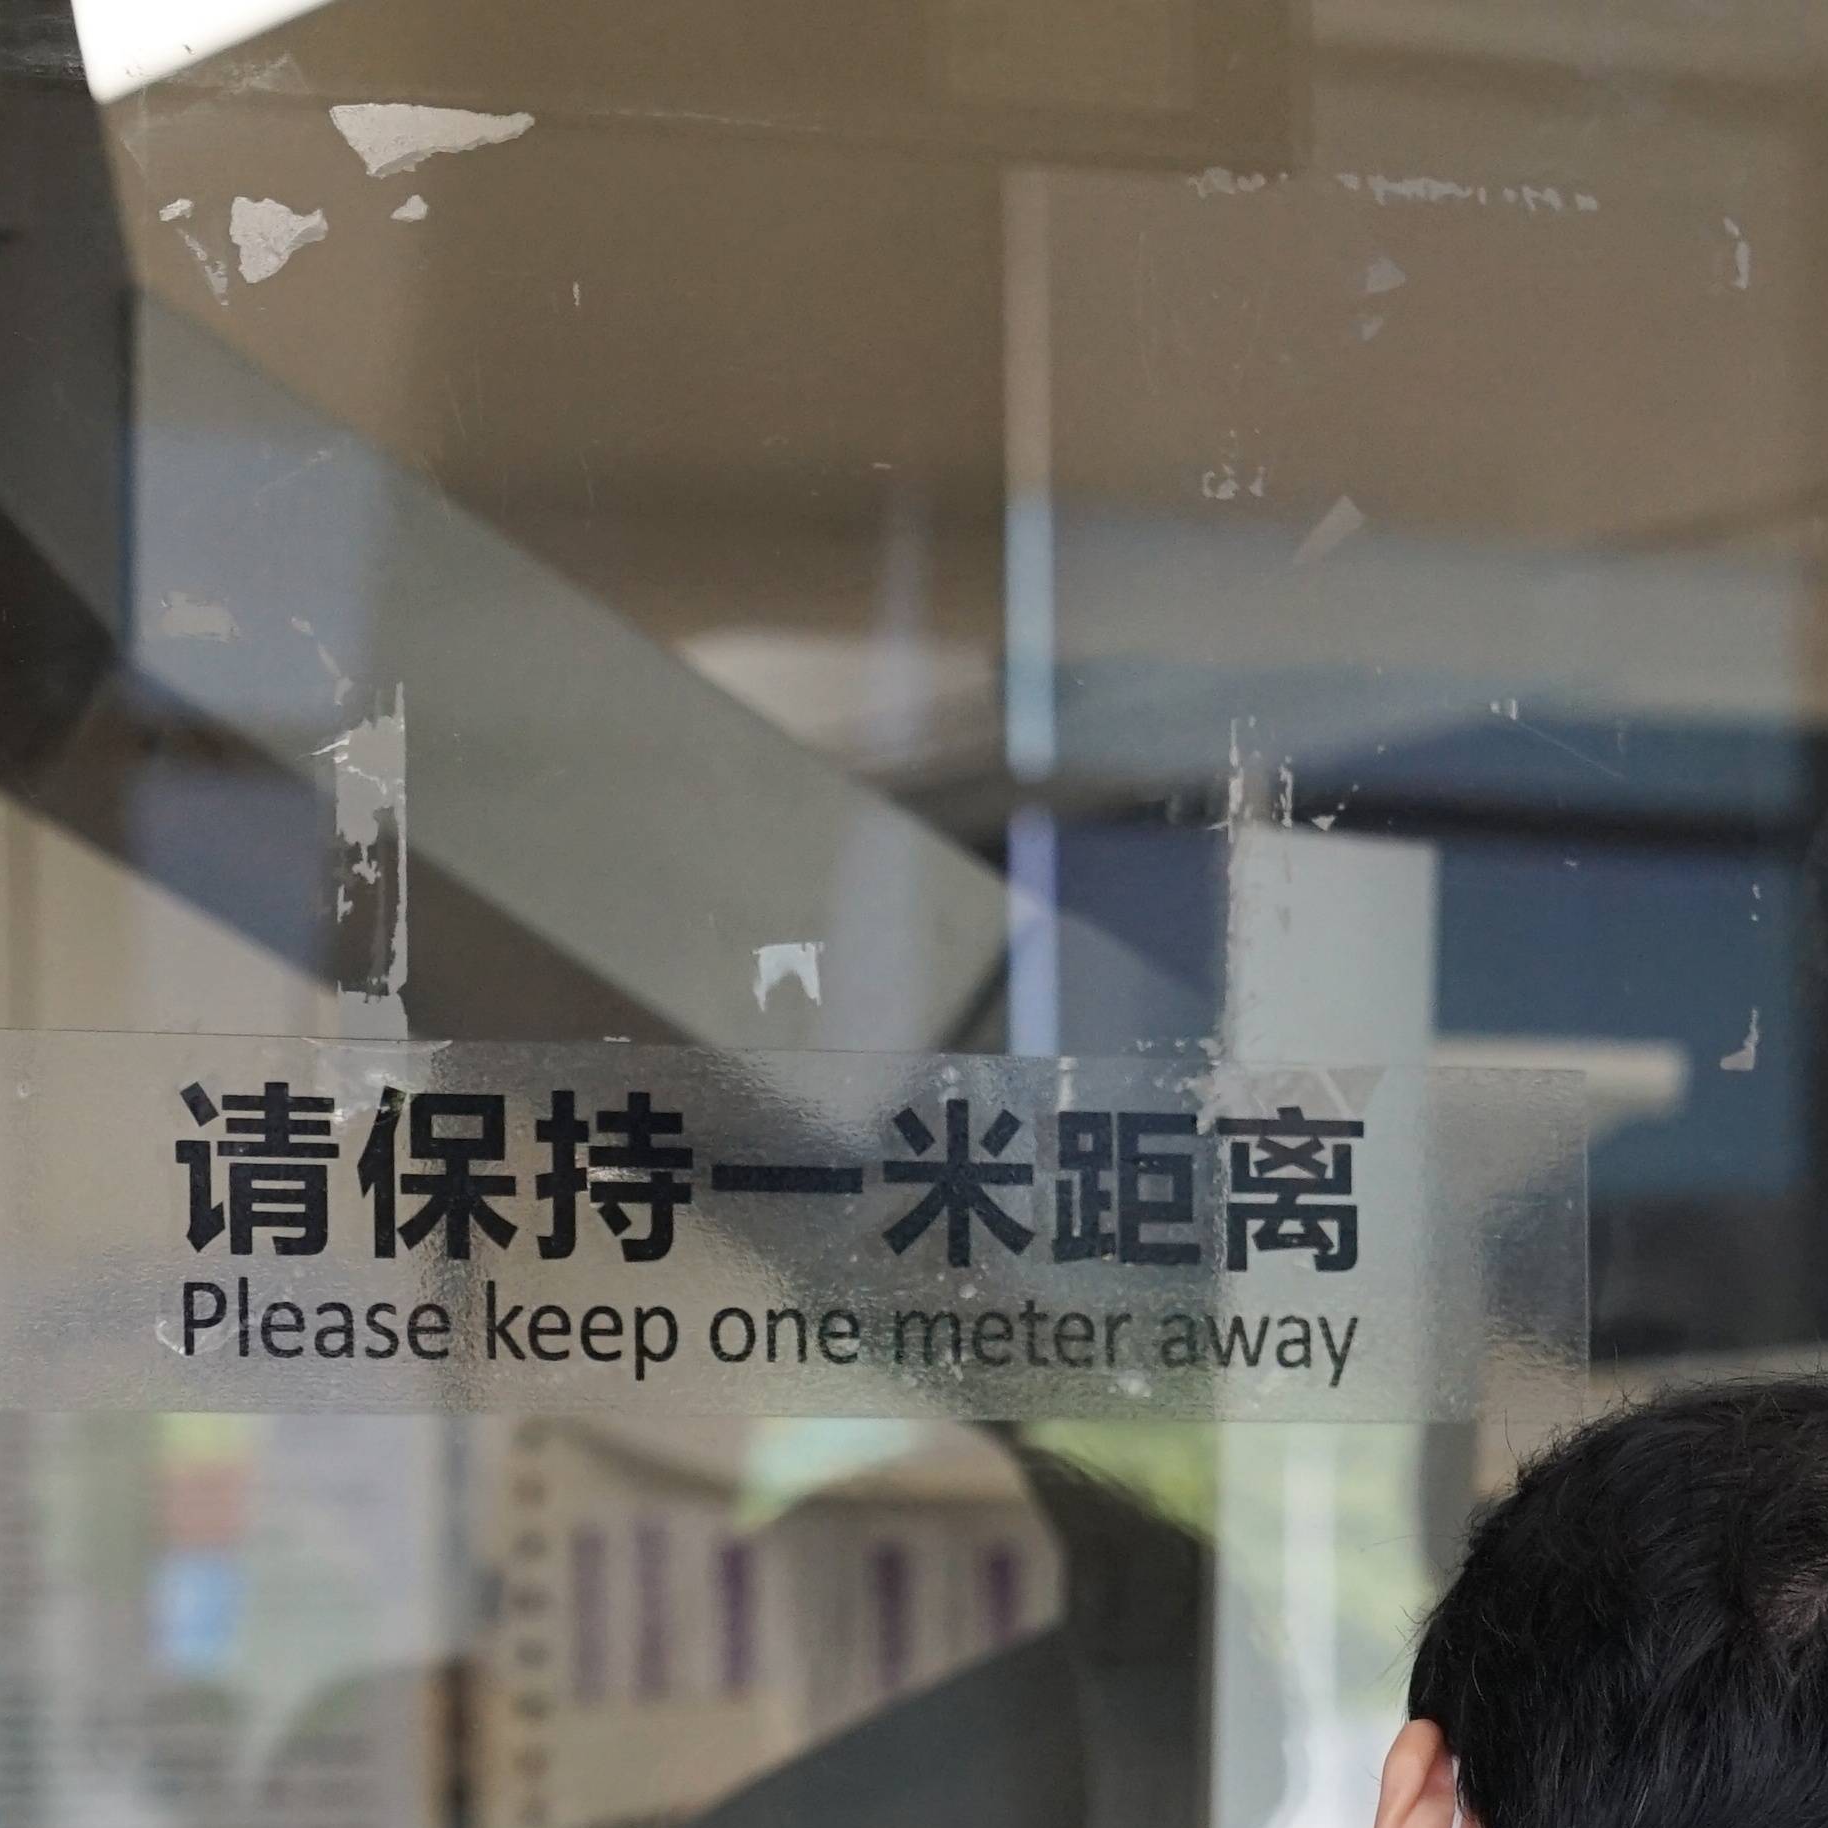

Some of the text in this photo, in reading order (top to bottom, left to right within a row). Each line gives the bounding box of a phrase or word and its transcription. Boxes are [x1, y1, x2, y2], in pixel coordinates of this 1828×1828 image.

[176, 1081, 1365, 1272] 请保持一米距离
[181, 1281, 1360, 1388] Please keep one meter away
